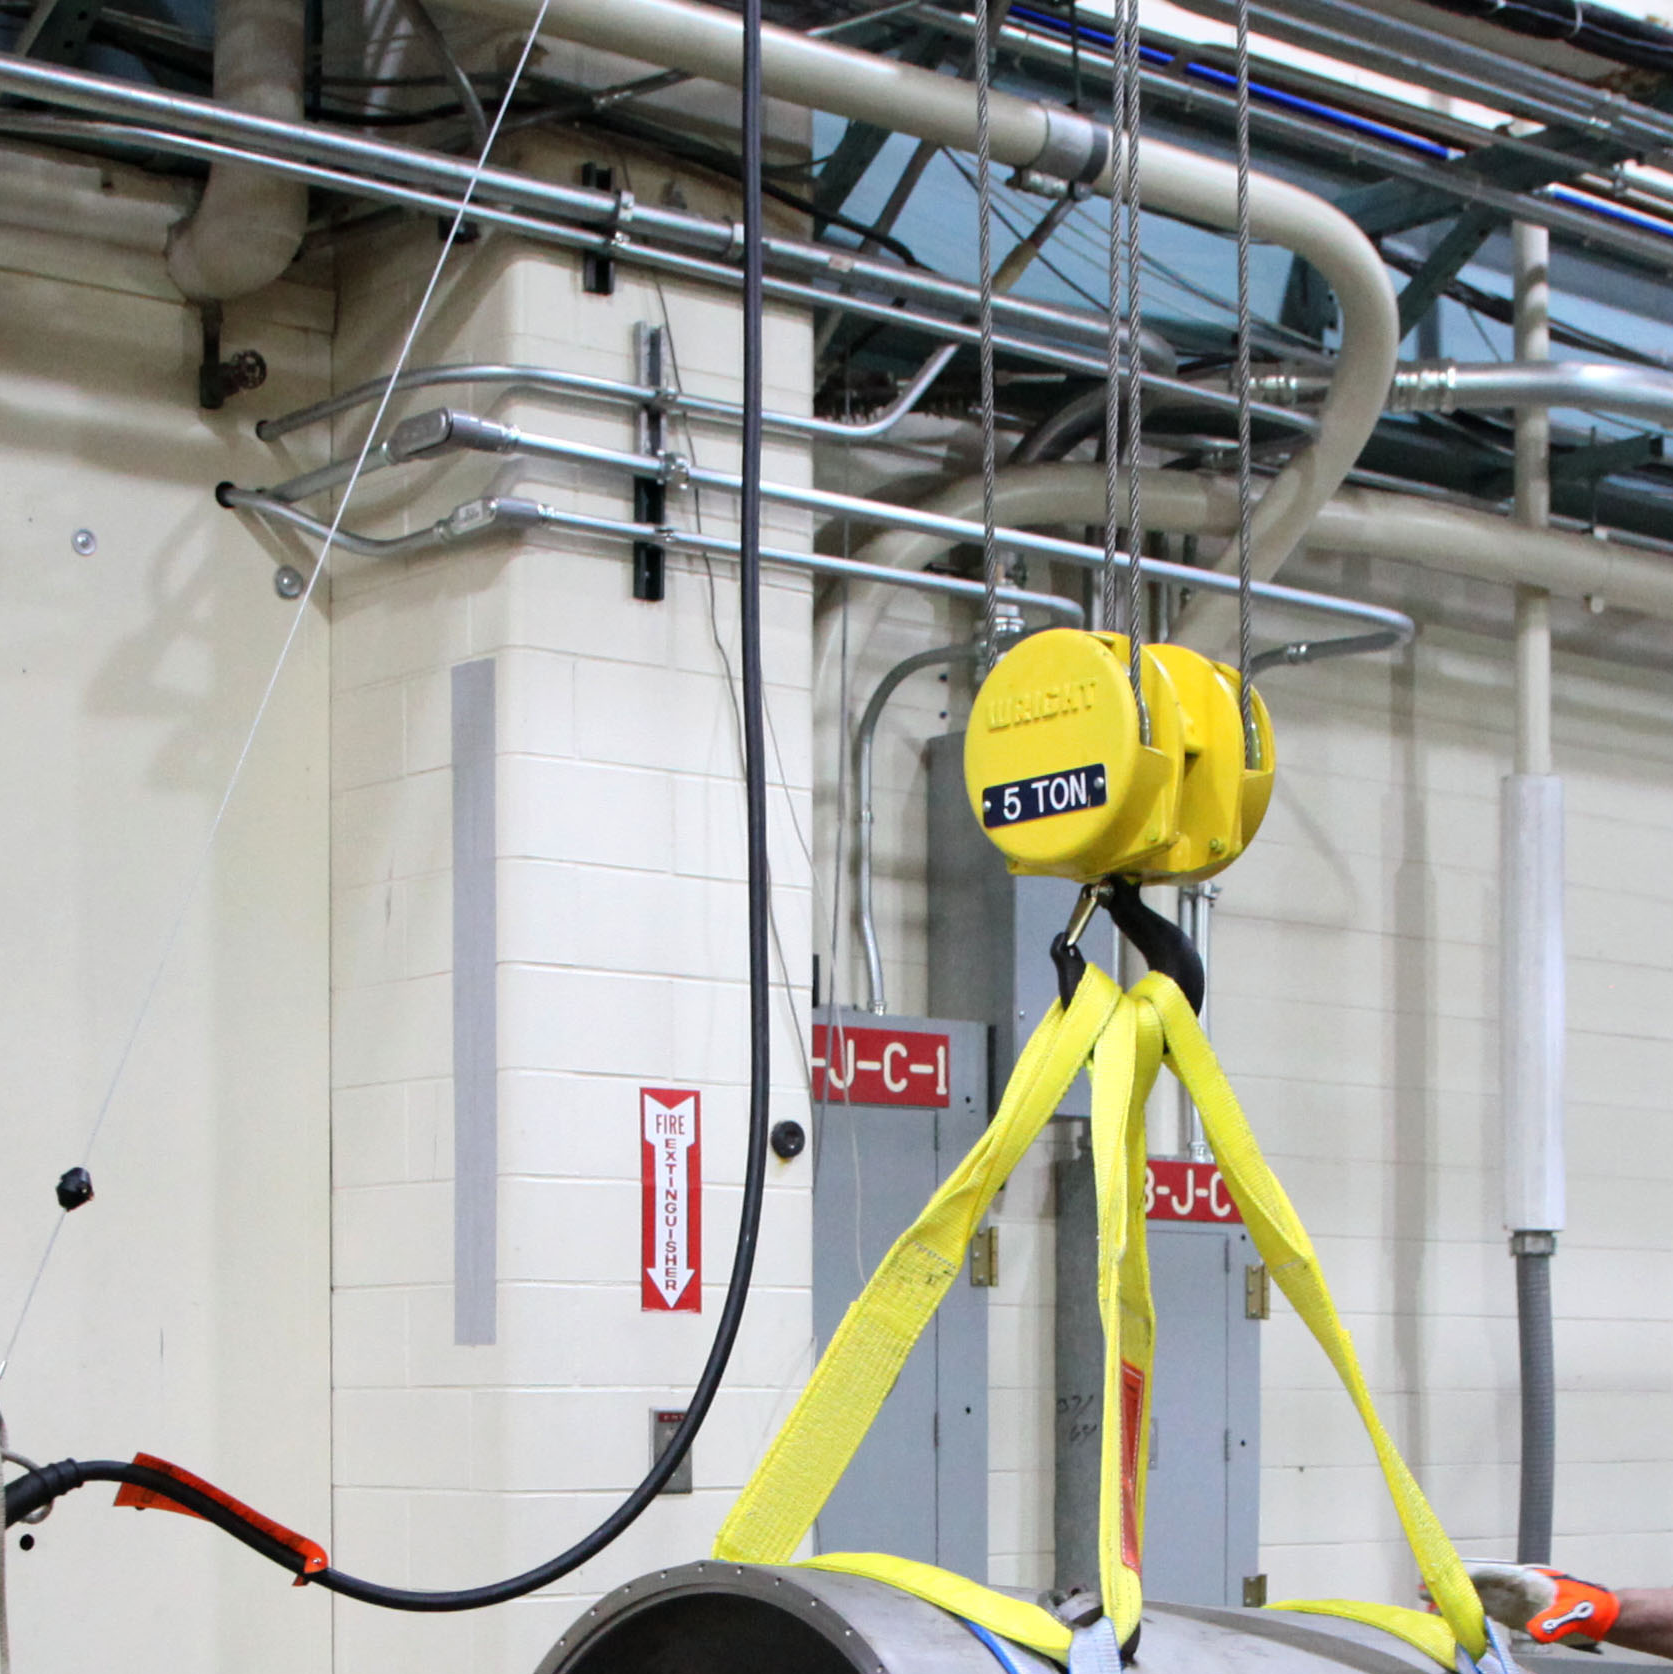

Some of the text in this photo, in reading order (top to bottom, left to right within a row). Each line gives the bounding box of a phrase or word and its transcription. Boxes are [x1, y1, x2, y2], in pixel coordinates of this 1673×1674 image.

[988, 681, 1097, 733] WRIGHT
[1003, 772, 1087, 820] 5 TON
[655, 1113, 686, 1136] FIRE
[664, 1137, 678, 1291] EXTINGUISHER
